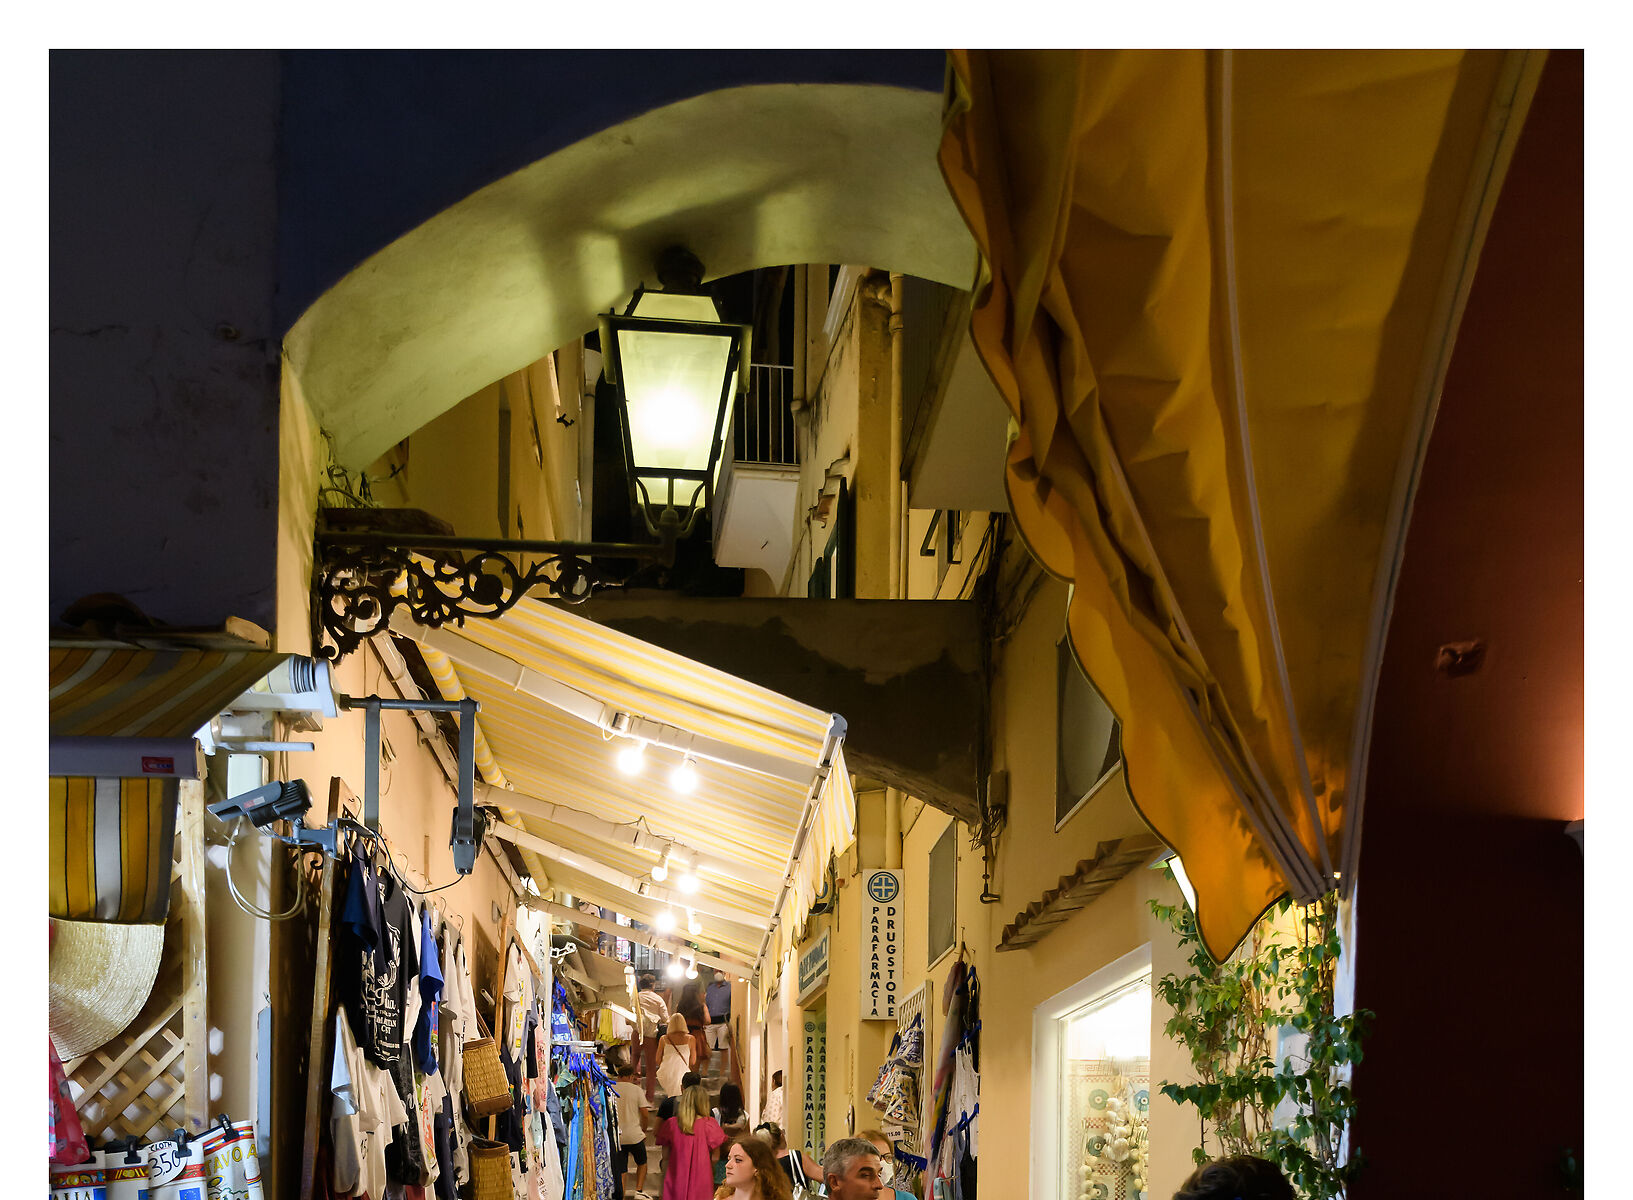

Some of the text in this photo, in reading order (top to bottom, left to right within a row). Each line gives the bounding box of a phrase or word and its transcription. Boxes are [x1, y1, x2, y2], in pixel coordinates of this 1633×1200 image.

[870, 906, 880, 1017] PARAFARMACIA
[886, 906, 896, 1017] DRUGSTORE
[804, 1036, 814, 1149] PARAFARMACIA
